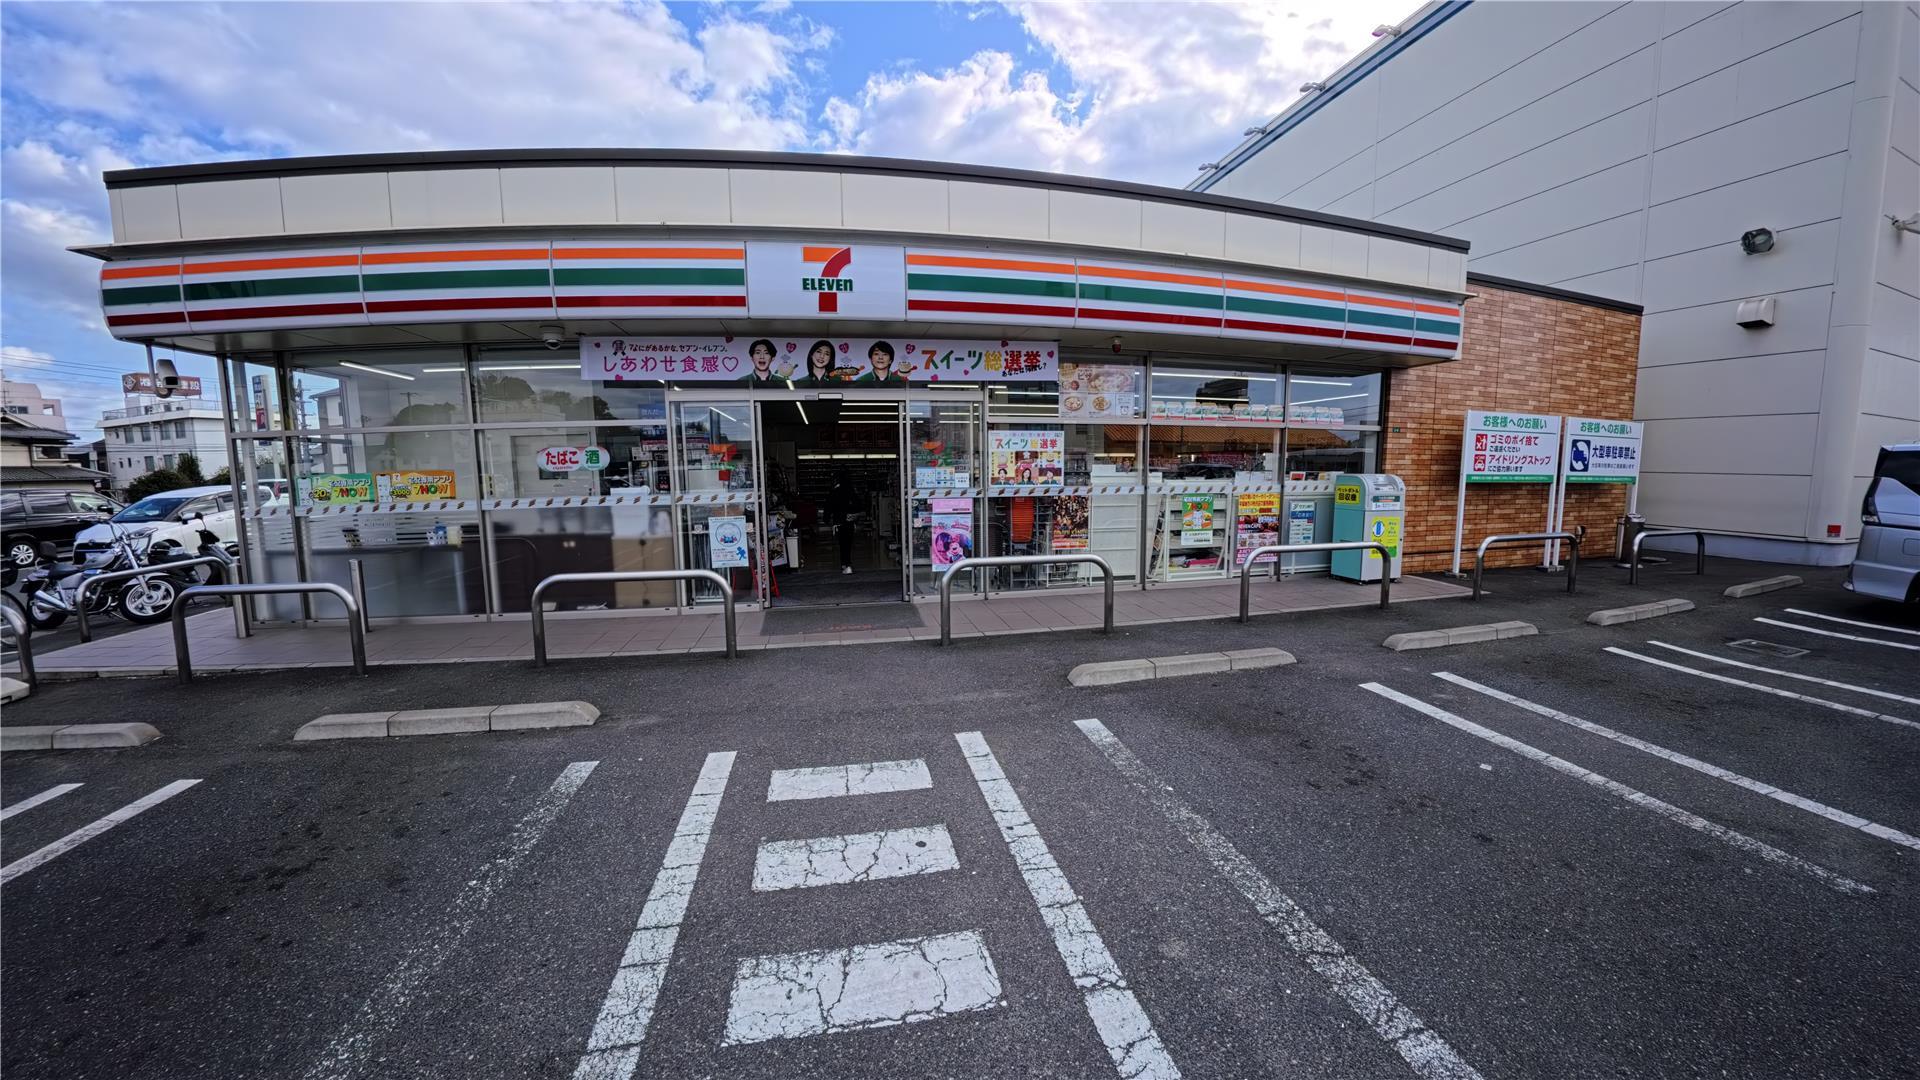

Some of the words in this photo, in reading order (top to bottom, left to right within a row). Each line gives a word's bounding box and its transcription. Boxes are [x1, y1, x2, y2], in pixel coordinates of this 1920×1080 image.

[802, 246, 851, 312] 7
[921, 350, 1041, 371] スイーツ総選挙
[1483, 415, 1547, 429] お客様へのお願い
[1580, 422, 1632, 435] お客様へのお願い
[1490, 433, 1539, 446] ゴミのポイ捨て
[545, 450, 579, 466] たばこ
[584, 449, 600, 465] 酒
[1591, 445, 1636, 460] 大型車駐車禁止
[1488, 454, 1552, 466] アイドリングストップ
[333, 487, 368, 498] 7NOW
